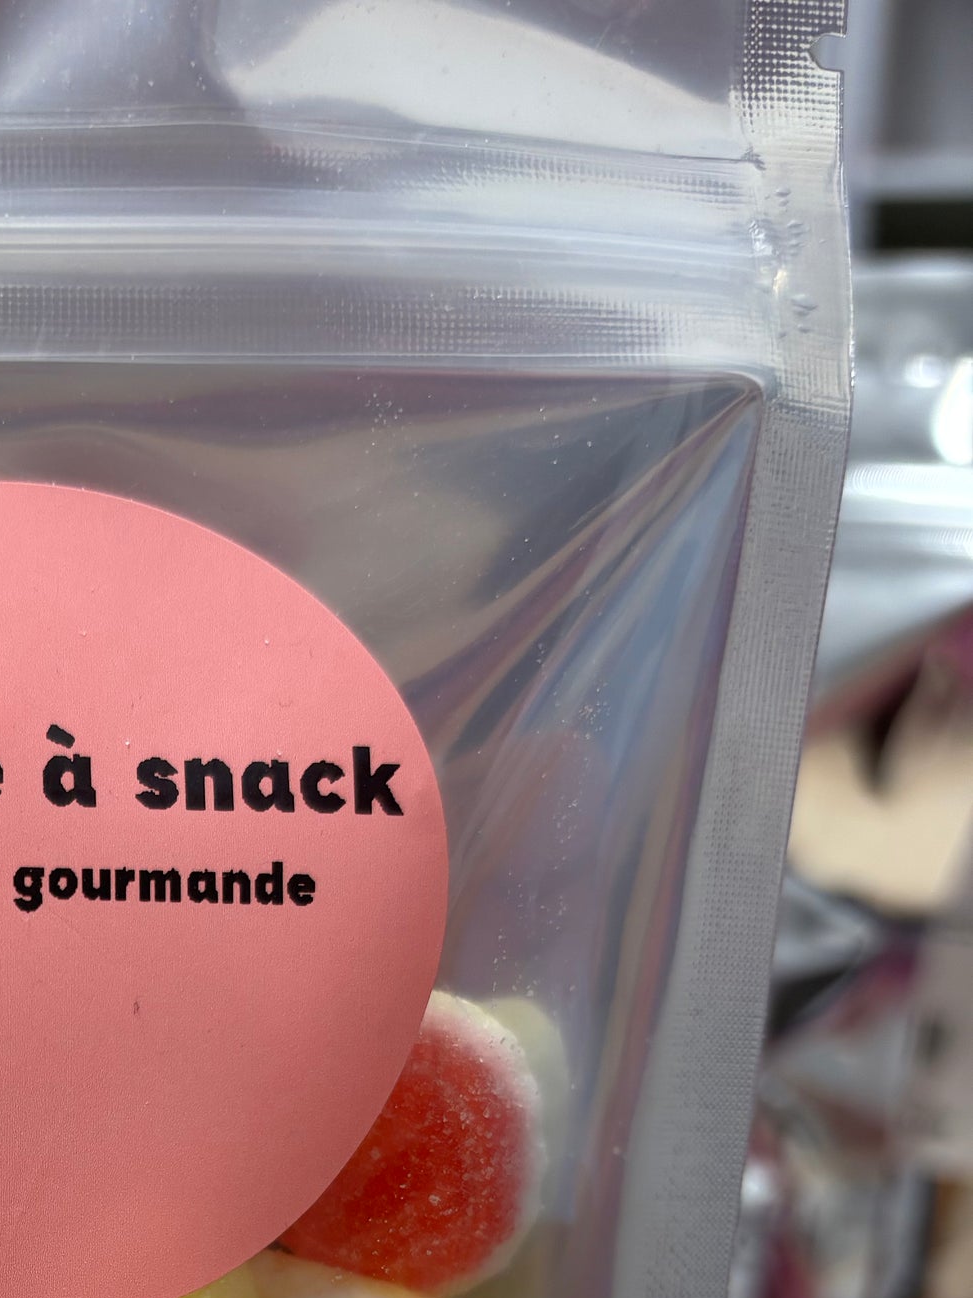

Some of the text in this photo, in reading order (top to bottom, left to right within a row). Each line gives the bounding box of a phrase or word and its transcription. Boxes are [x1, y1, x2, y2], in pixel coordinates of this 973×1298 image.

[43, 723, 97, 808] à
[135, 745, 405, 817] snack
[12, 860, 317, 914] gourmande
